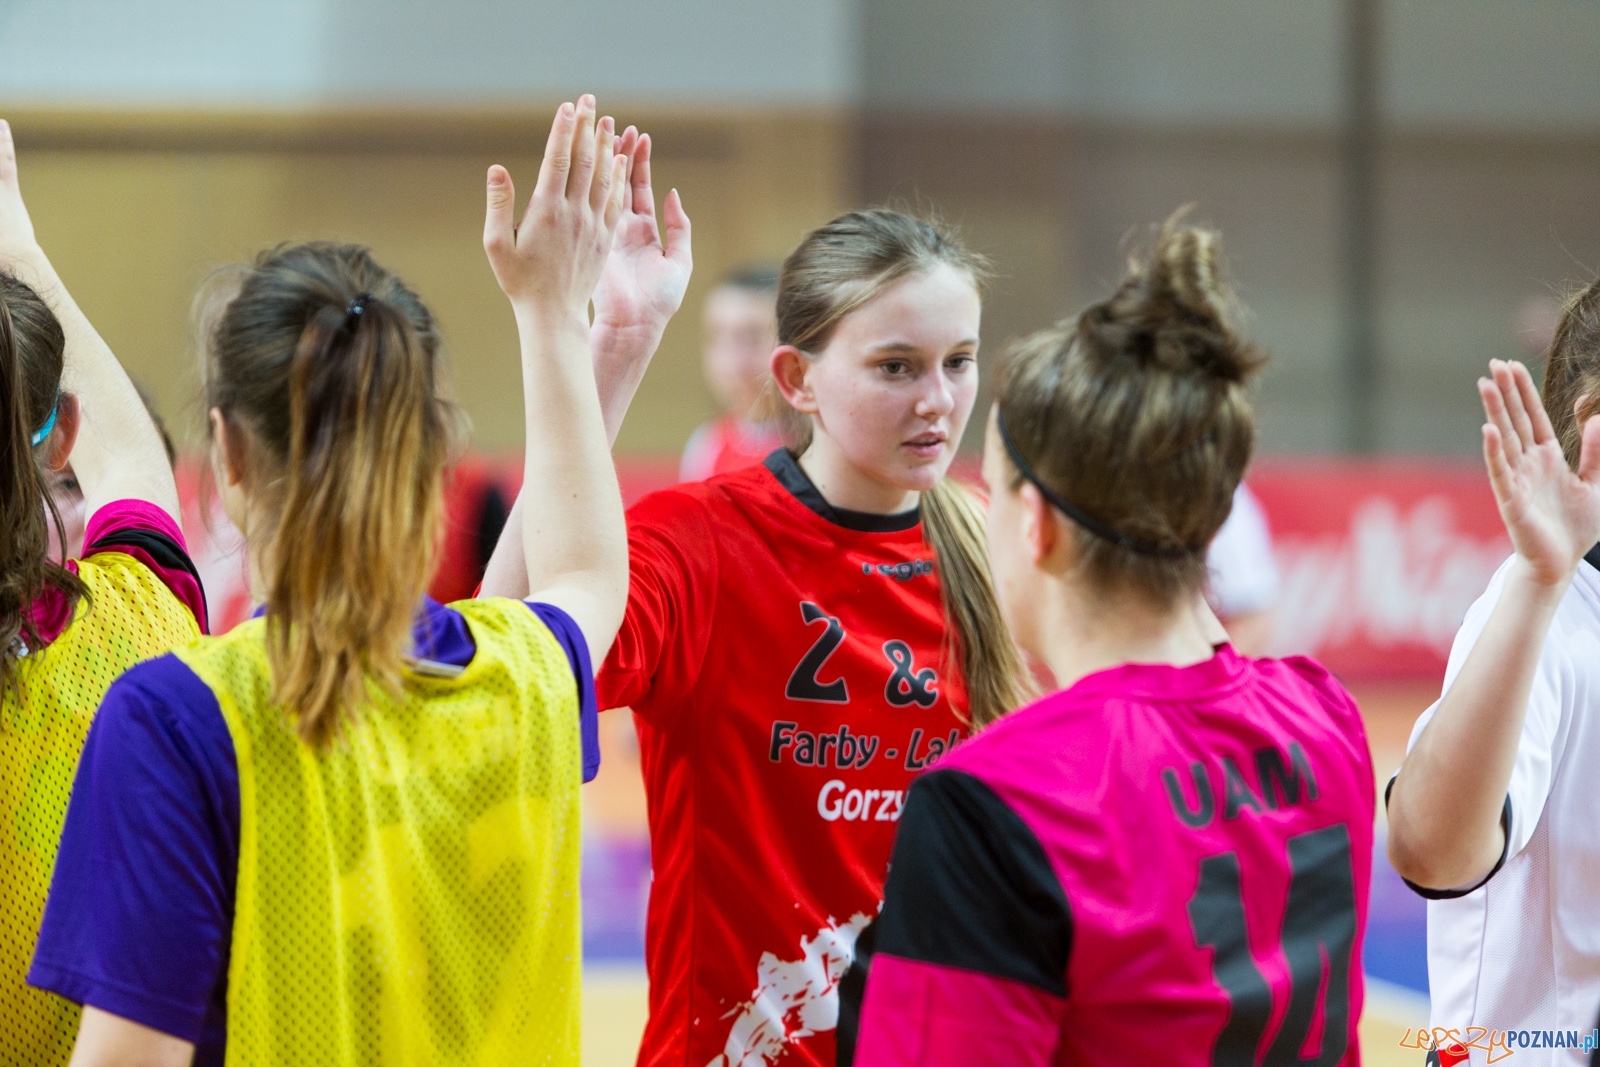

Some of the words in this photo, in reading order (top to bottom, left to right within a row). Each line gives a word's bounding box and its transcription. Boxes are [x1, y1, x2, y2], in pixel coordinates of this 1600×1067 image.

[882, 639, 938, 710] &
[769, 720, 879, 769] Farby
[1161, 741, 1320, 829] UAM
[1186, 822, 1357, 1067] 14
